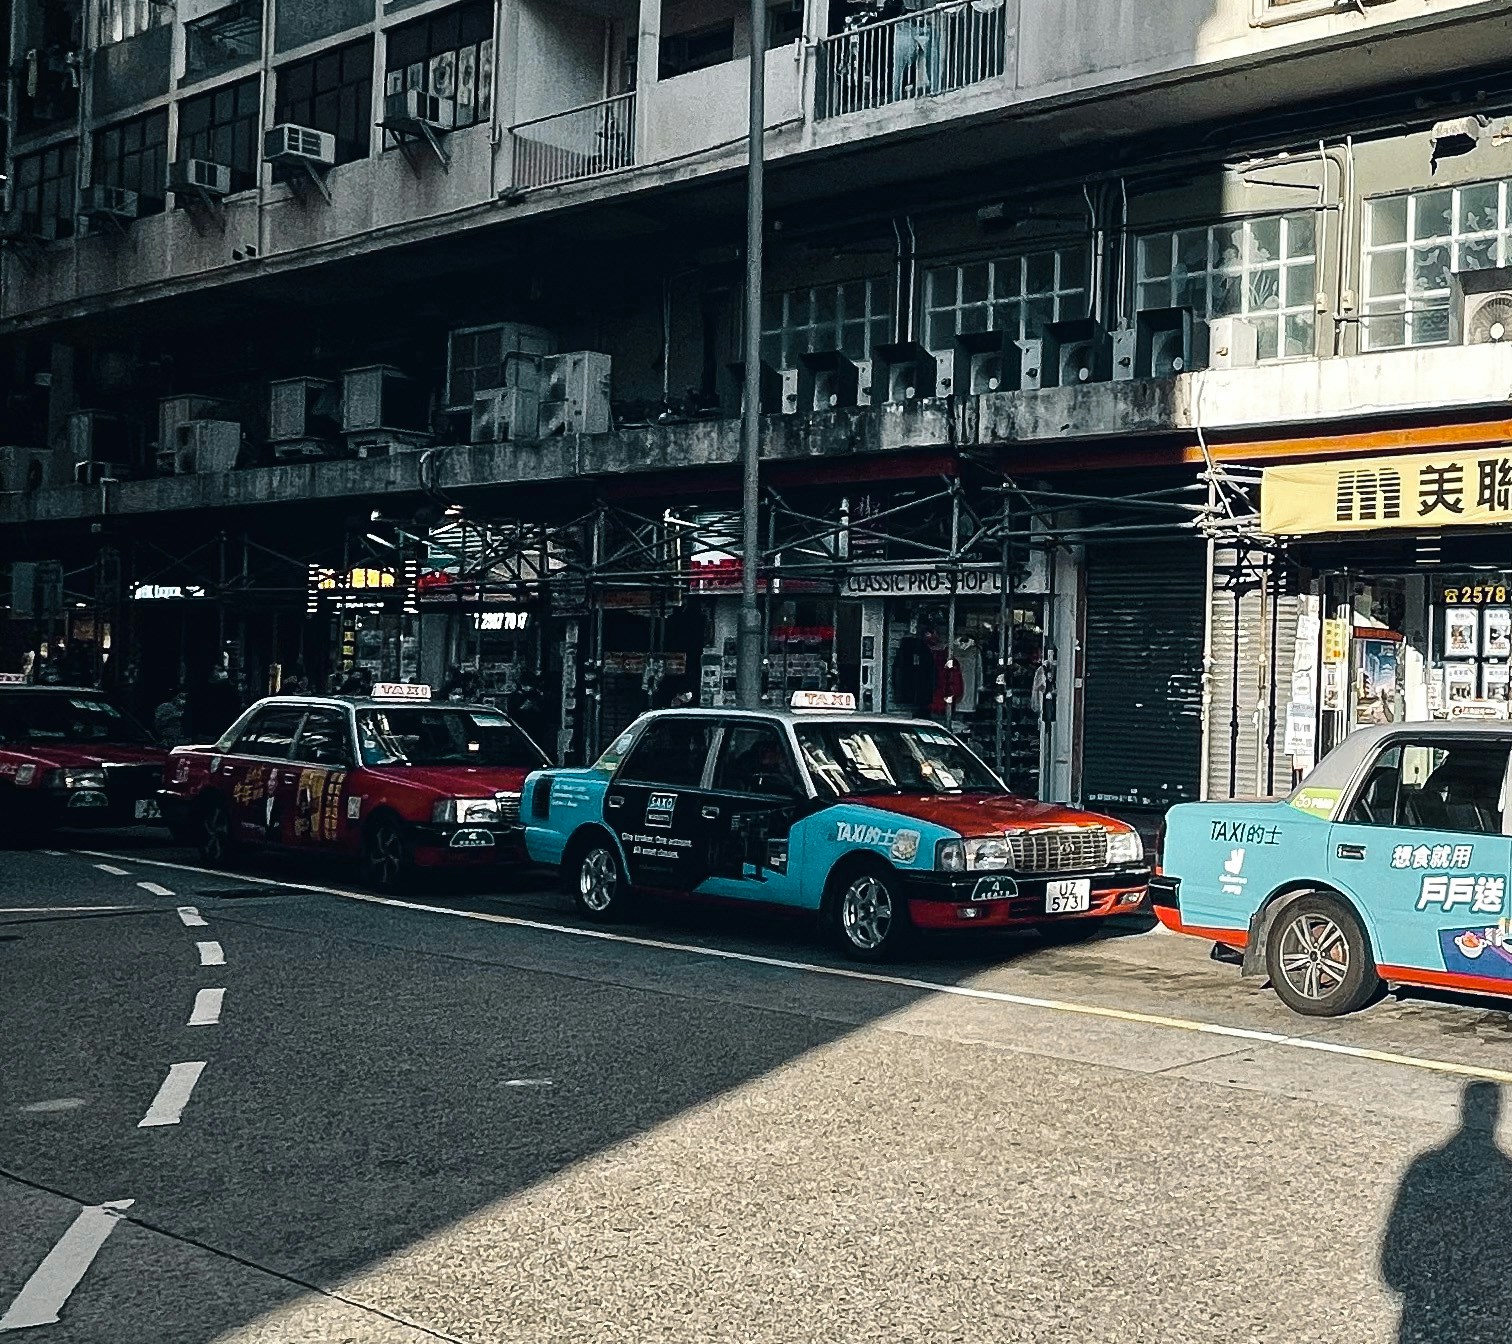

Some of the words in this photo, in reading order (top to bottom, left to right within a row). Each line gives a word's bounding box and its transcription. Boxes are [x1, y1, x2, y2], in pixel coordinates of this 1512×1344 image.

[849, 573, 904, 593] CLASSIC
[1461, 586, 1506, 603] 2578
[381, 684, 428, 696] TAXI
[804, 692, 851, 706] TAXI
[1391, 844, 1474, 869] 想食就用
[1059, 881, 1077, 896] UZ
[1416, 874, 1506, 913] 戶戶送
[1051, 894, 1085, 912] 5731
